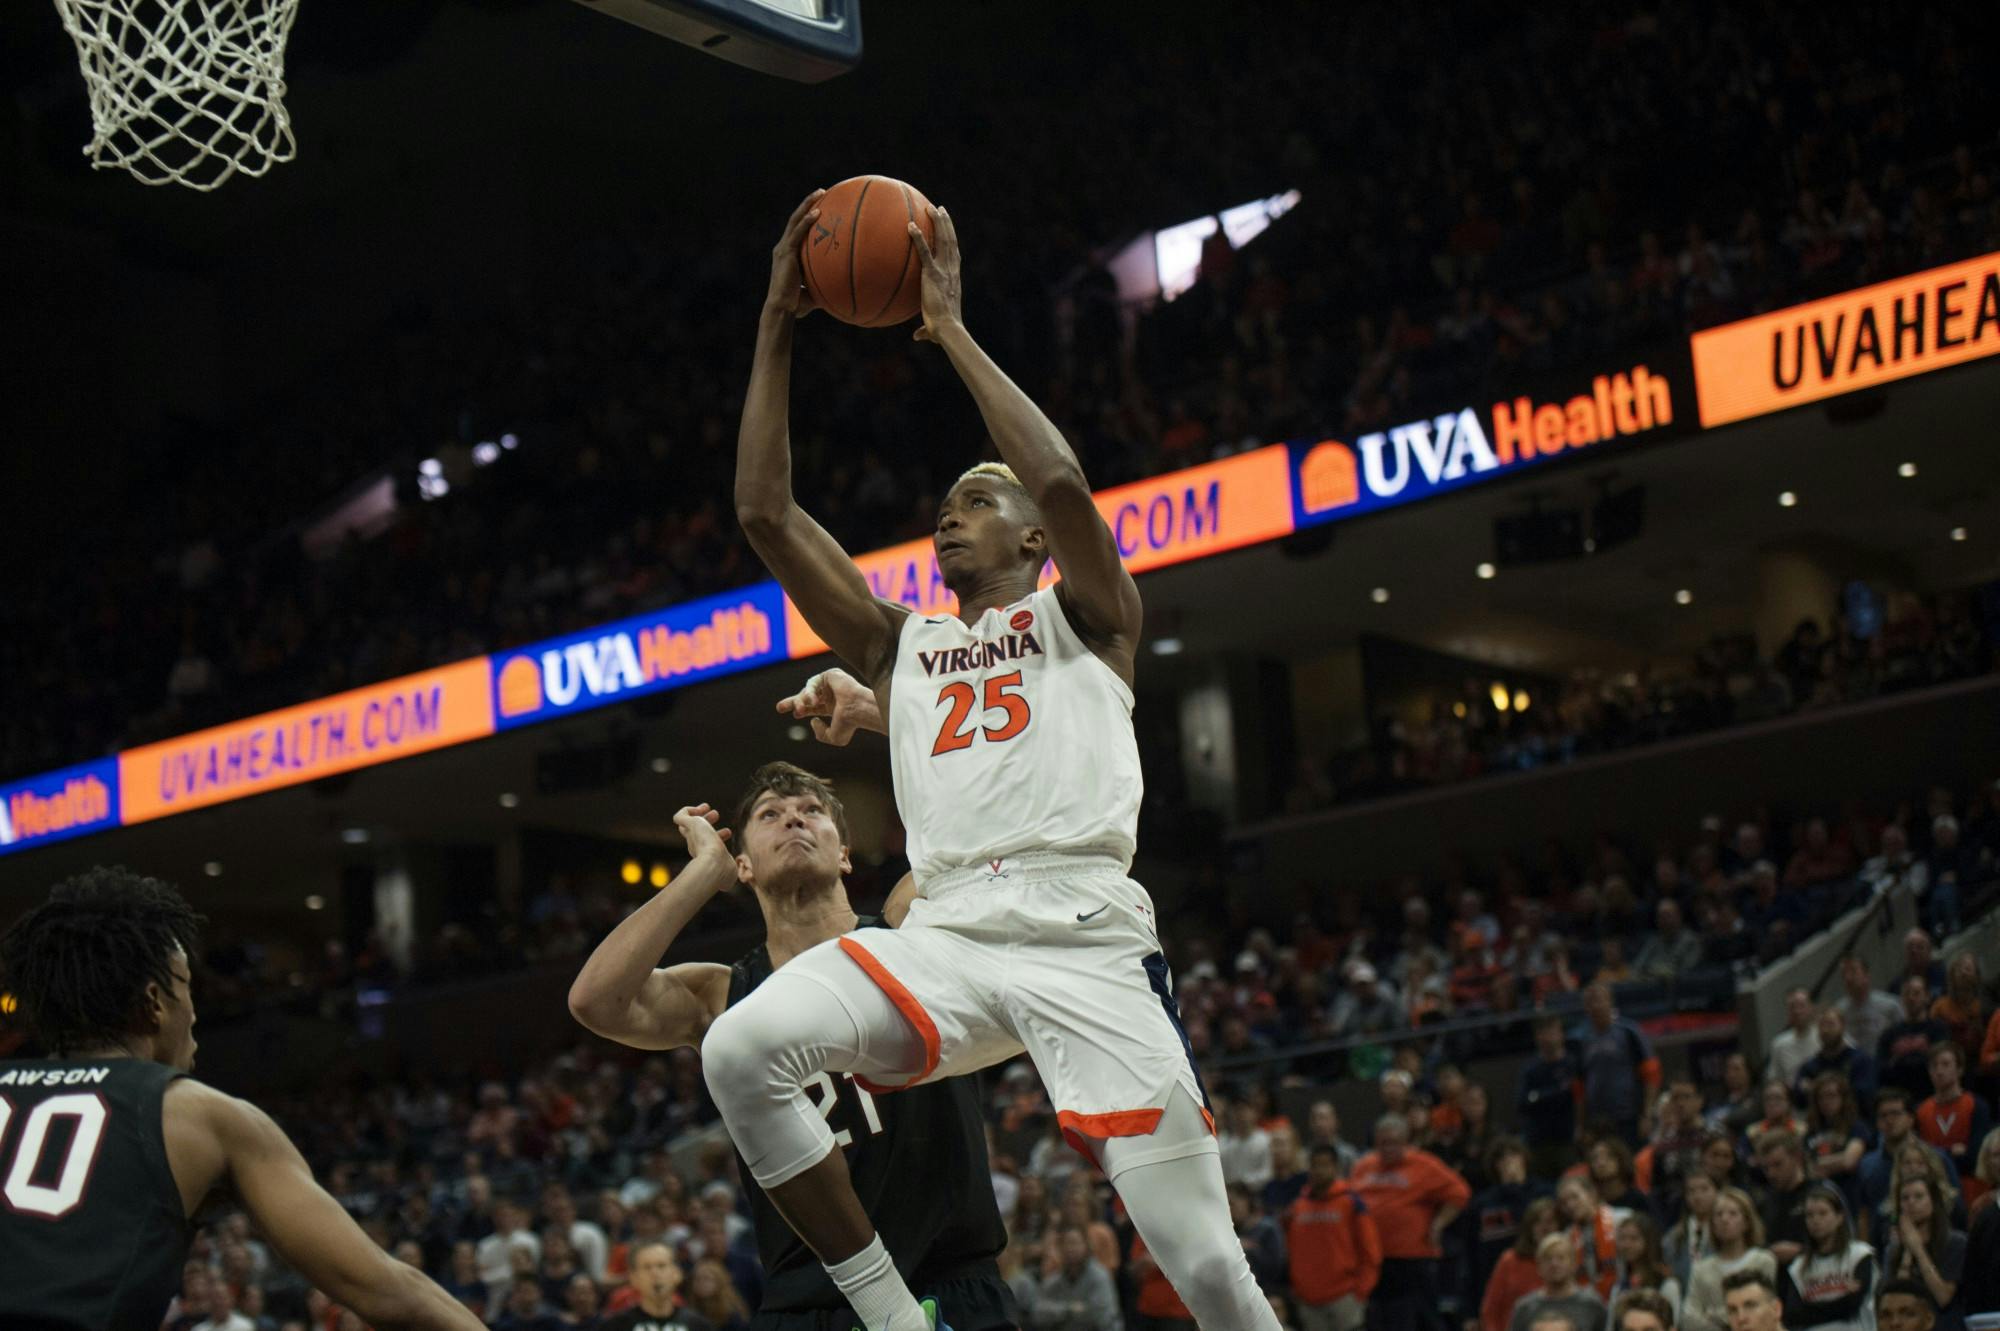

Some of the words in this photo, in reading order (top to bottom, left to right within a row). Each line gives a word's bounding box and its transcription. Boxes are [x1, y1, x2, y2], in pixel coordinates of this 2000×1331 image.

[1359, 407, 1499, 497] UVA
[1492, 365, 1673, 465] Health
[542, 632, 644, 706] UVA
[638, 602, 770, 682] Health
[917, 632, 1045, 678] VIRGINIA
[160, 687, 441, 801] UVAHEALTH.COM
[931, 669, 1031, 757] 25
[10, 775, 109, 840] Health
[800, 1070, 883, 1148] 21
